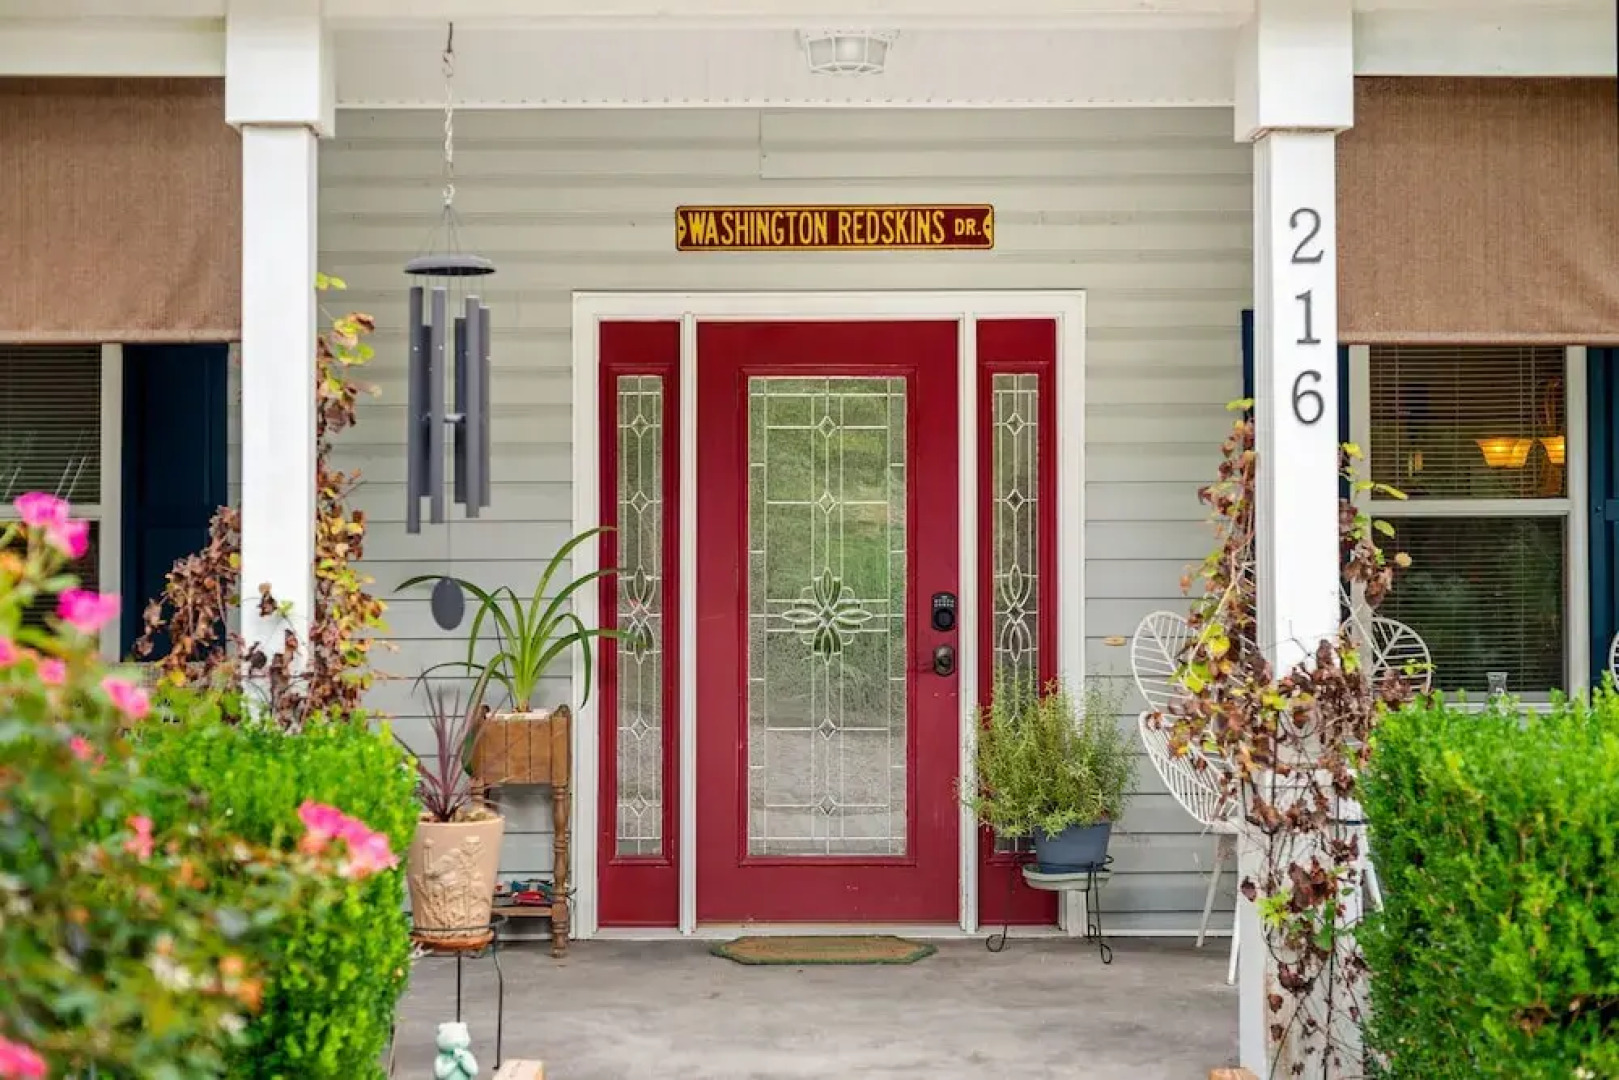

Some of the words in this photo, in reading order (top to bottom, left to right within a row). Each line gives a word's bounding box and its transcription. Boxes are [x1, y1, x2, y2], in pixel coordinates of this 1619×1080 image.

[688, 210, 828, 244] WASHINGTON
[838, 210, 945, 244] REDSKINS
[954, 217, 982, 236] DR.
[1289, 207, 1324, 426] 216
